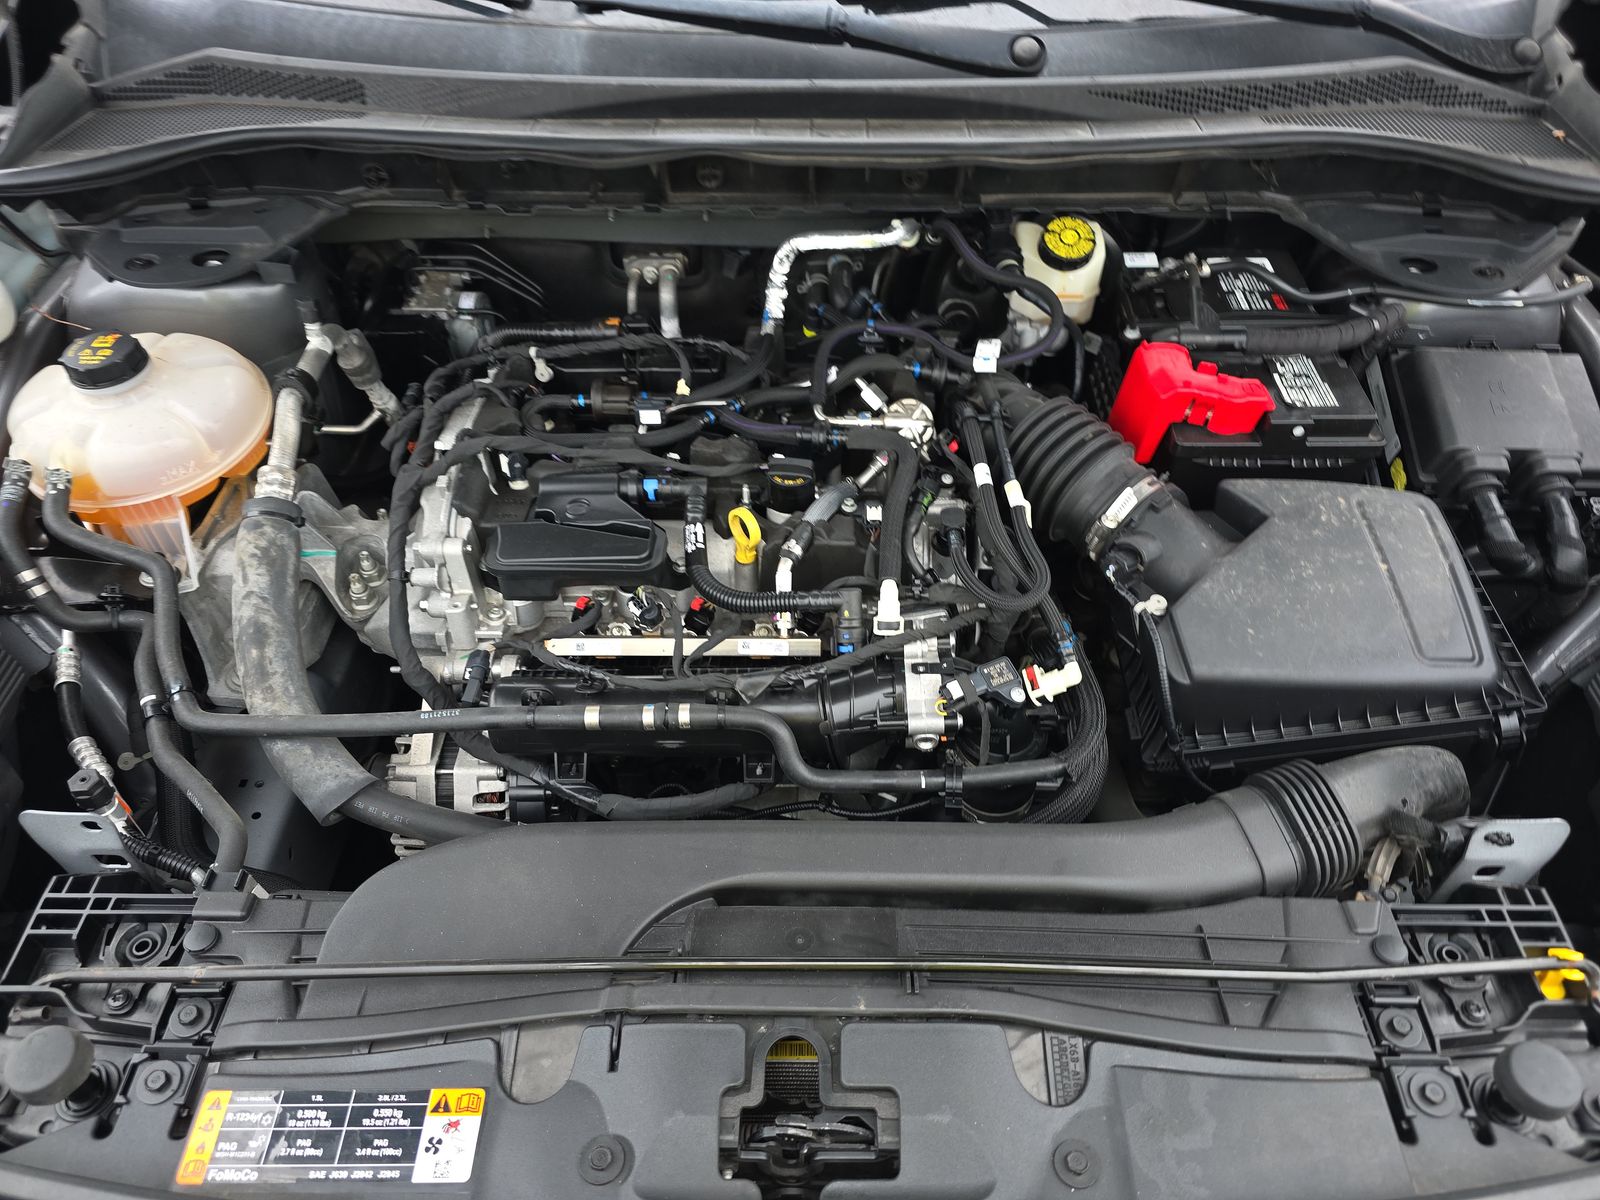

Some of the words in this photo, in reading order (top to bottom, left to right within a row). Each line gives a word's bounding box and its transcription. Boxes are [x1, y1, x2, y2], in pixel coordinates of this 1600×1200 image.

[217, 1141, 238, 1151] PAG
[296, 1139, 312, 1147] PAG
[373, 1139, 389, 1147] PAG
[207, 1168, 259, 1181] FoMoCo
[308, 1170, 326, 1179] SAE
